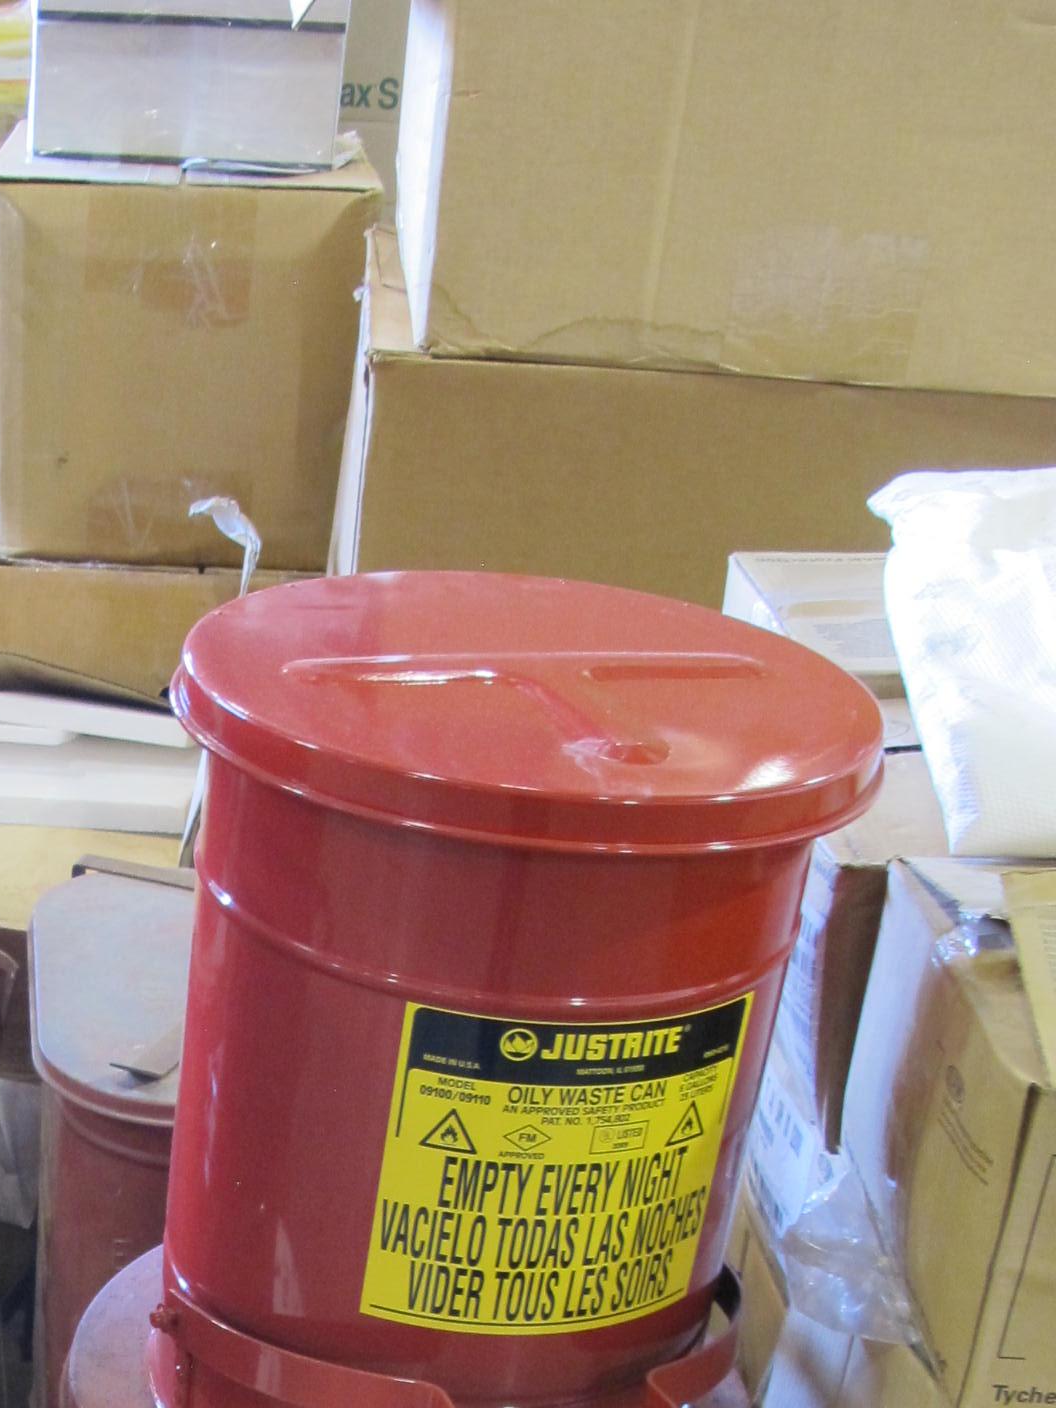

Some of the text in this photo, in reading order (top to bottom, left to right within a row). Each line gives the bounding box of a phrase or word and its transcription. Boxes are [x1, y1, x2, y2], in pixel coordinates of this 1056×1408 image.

[540, 1026, 683, 1061] JUSTRITE
[437, 1076, 477, 1092] MODEL
[508, 1086, 553, 1106] OILY
[559, 1086, 625, 1107] WASTE
[630, 1079, 668, 1102] CAN
[503, 1098, 665, 1117] AN APPROVED SAFETY PRODUCT
[498, 1150, 545, 1161] APPROVED
[438, 1145, 688, 1218] EMPTY EVERY NIGHT
[379, 1189, 708, 1270] VACIELO TODAS LAS NOCHES
[407, 1251, 673, 1323] VIDER TOUS LES SOIRS
[992, 1384, 1056, 1406] Tyche
